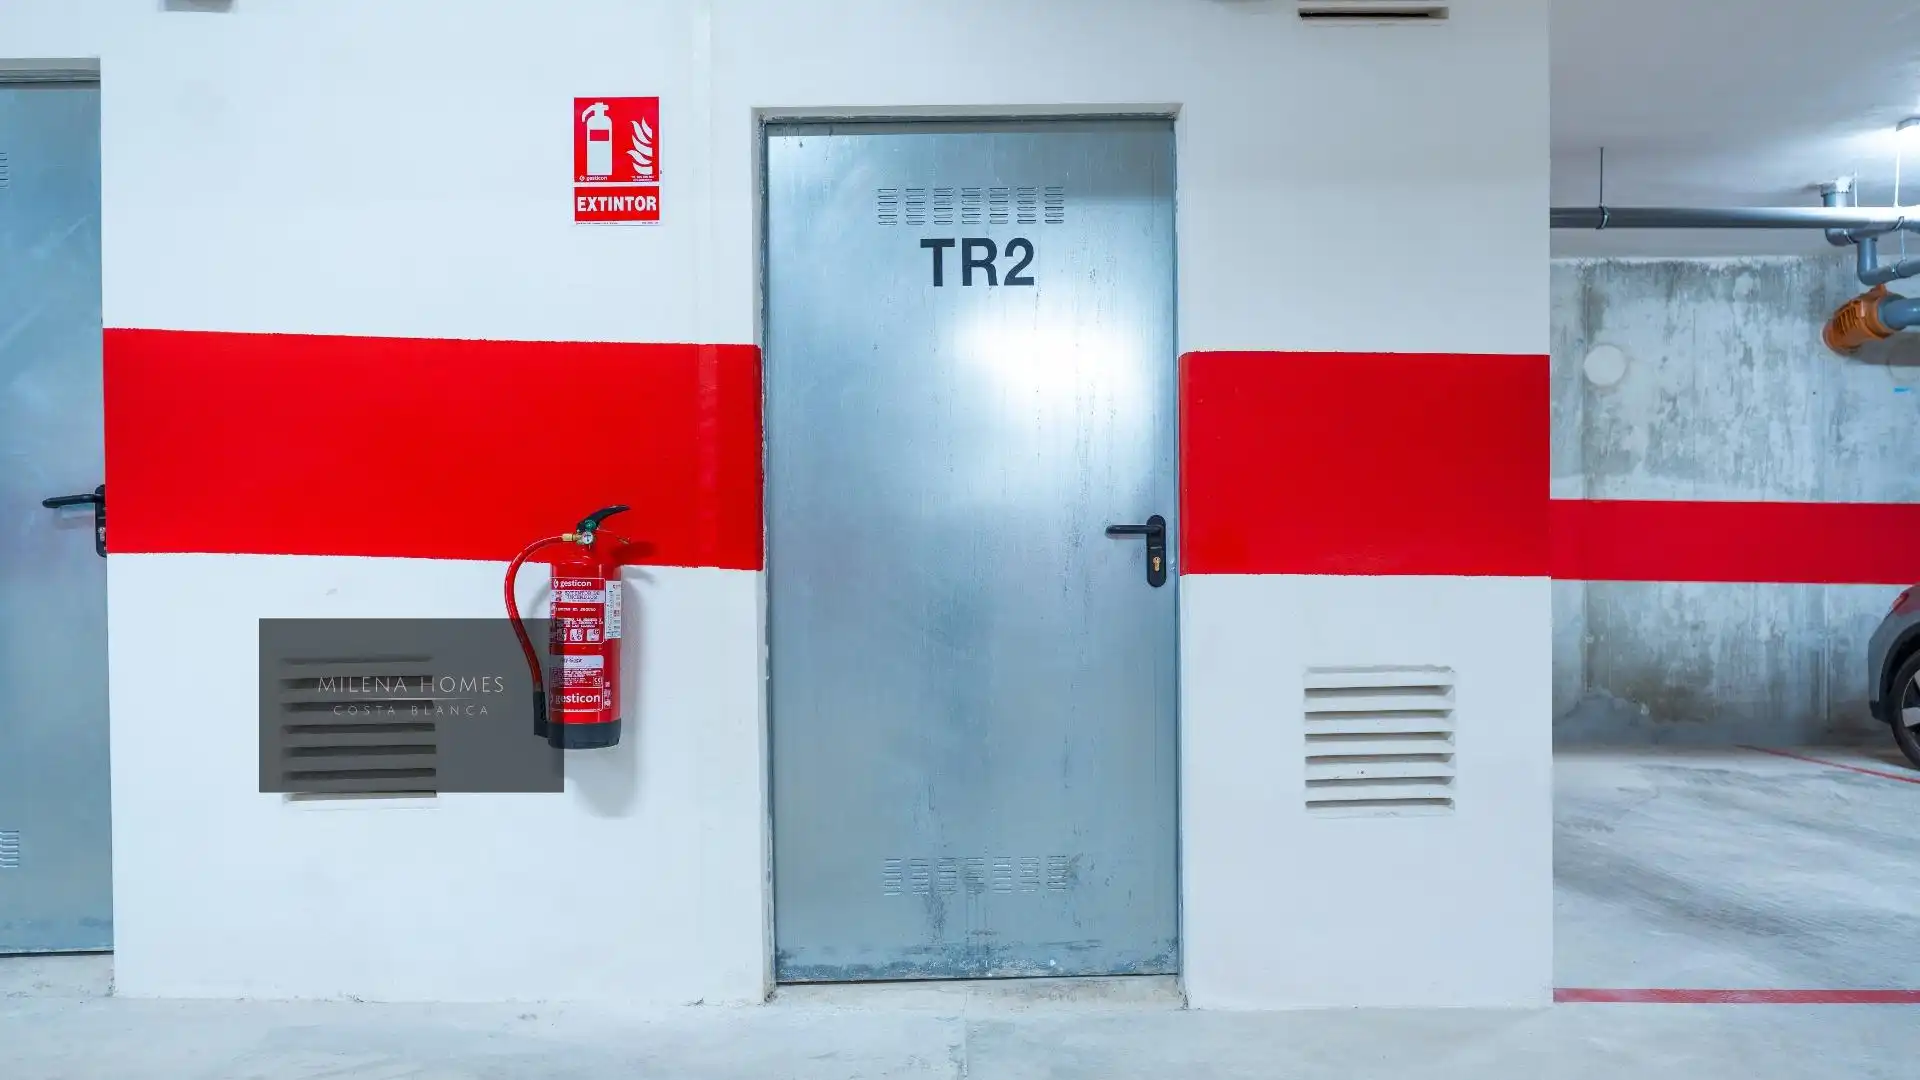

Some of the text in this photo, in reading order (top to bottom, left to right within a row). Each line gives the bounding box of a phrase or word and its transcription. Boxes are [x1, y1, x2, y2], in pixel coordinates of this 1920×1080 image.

[577, 195, 657, 212] EXTINTOR
[920, 237, 1035, 287] TR2
[560, 580, 592, 589] gesticon
